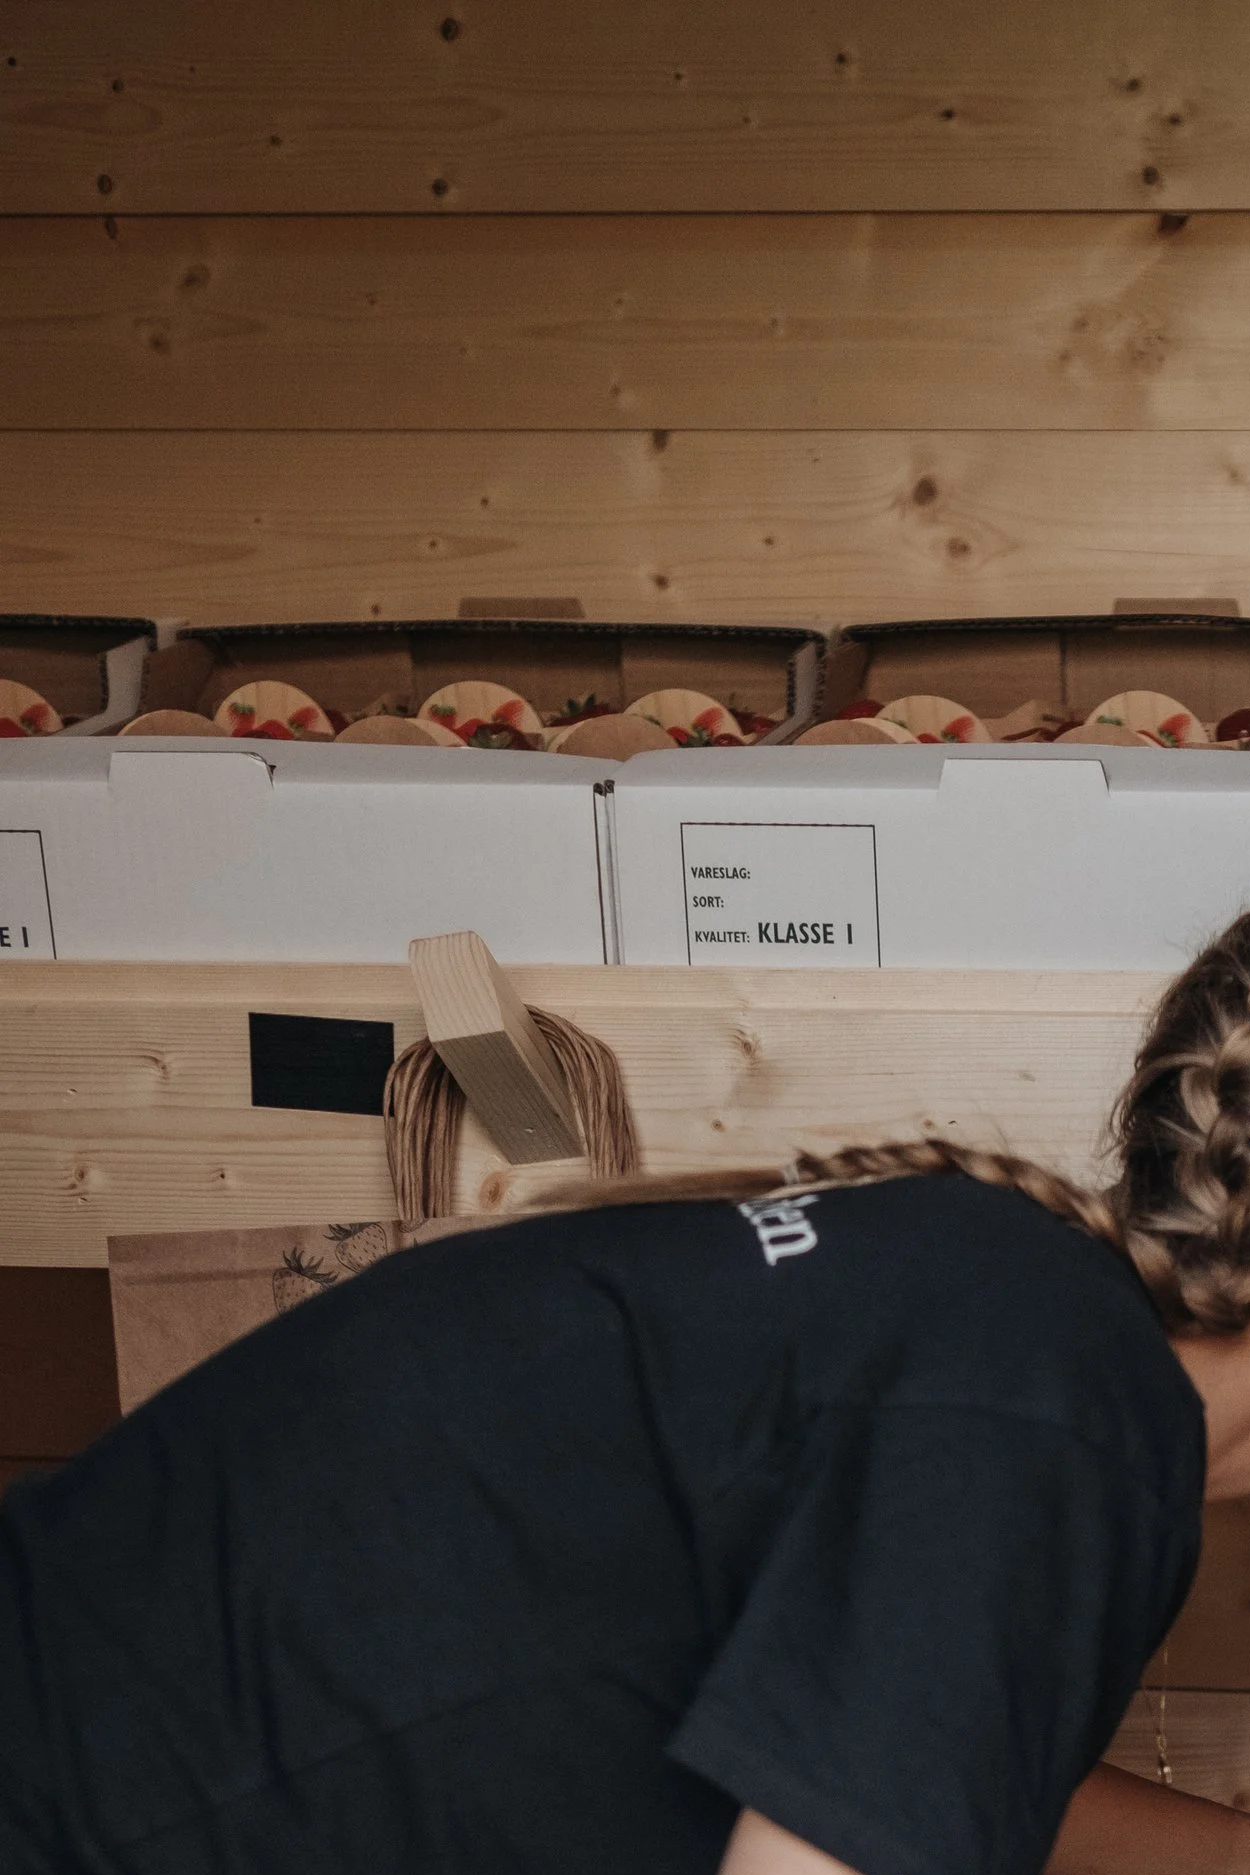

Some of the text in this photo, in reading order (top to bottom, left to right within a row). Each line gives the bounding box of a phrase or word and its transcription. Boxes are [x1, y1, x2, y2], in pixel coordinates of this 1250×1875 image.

[690, 866, 751, 880] VARESLAG:
[692, 896, 725, 908] SORT:
[695, 922, 853, 945] KVALITET: KLASSE I
